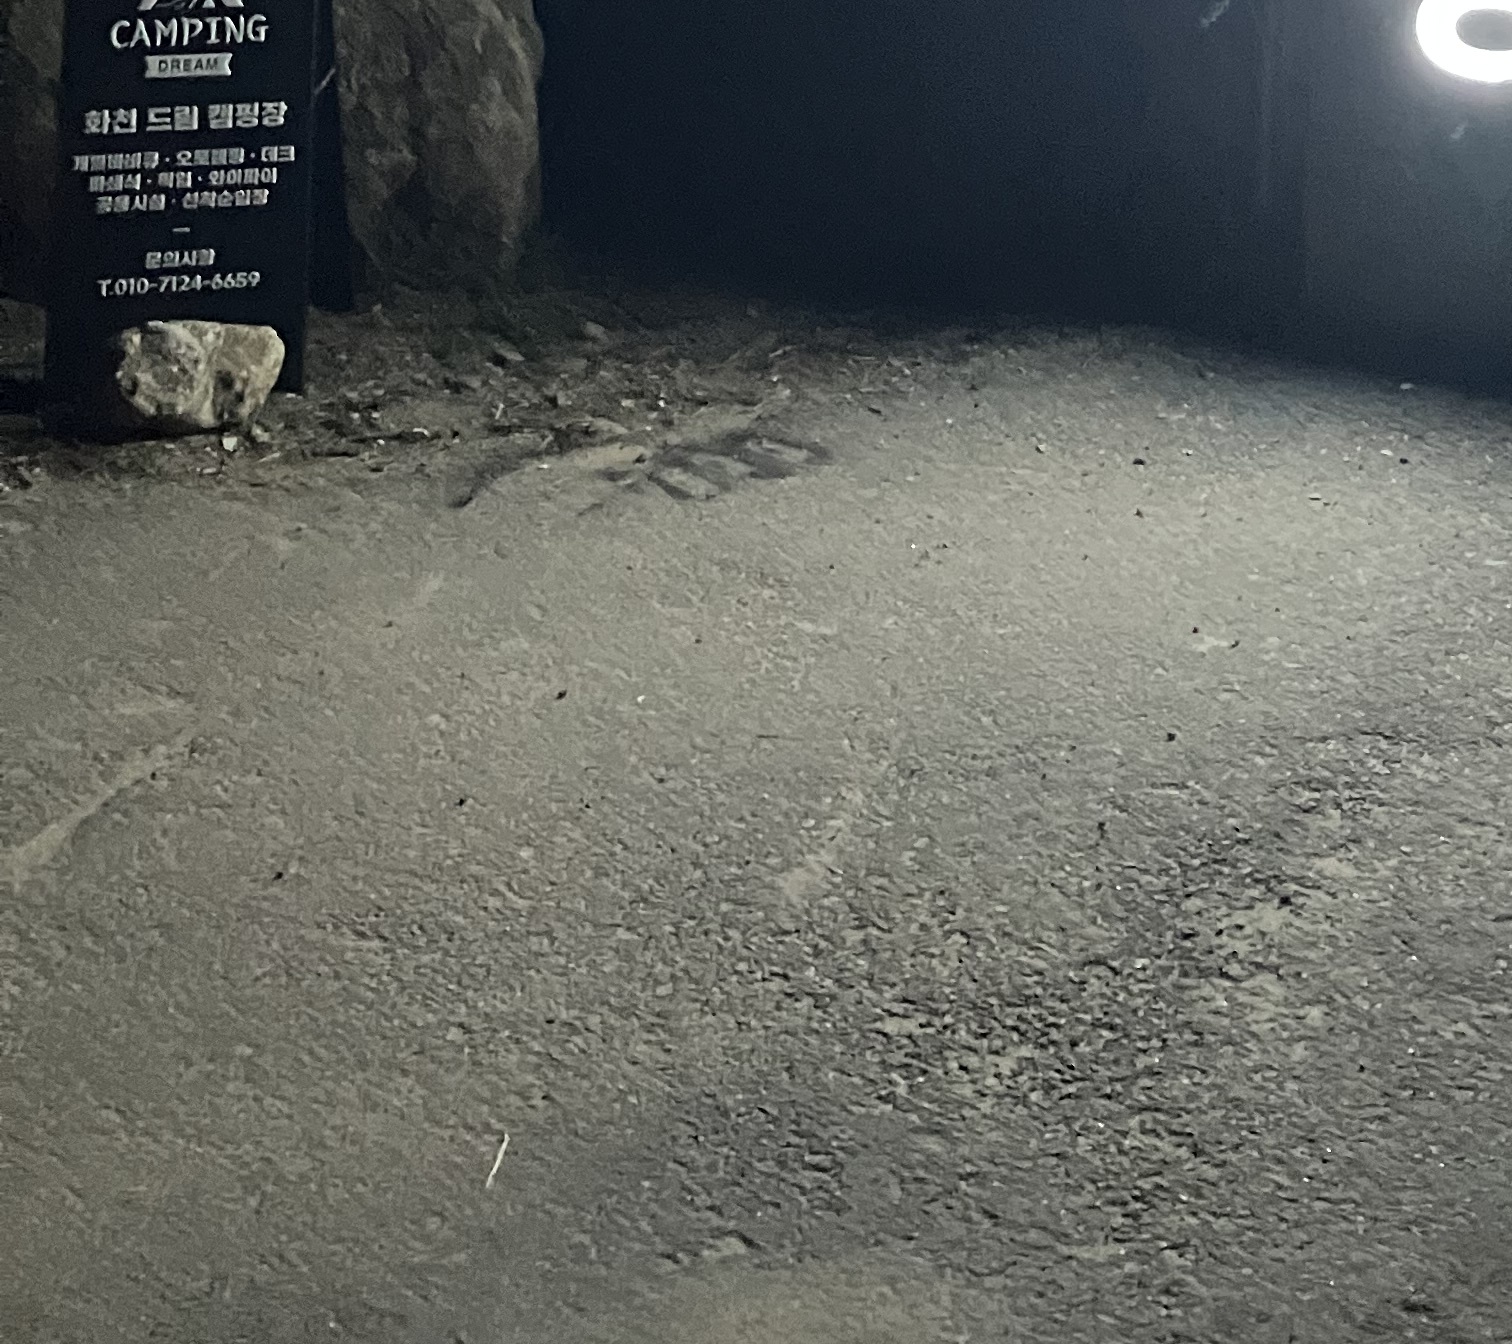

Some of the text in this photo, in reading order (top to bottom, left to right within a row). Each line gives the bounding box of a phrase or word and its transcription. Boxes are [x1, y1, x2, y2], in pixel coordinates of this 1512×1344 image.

[111, 14, 268, 48] CAMPING
[158, 58, 218, 72] DREAM
[85, 101, 287, 134] 화천 드림 캠핑장
[261, 146, 295, 162] 데크
[209, 167, 277, 185] 와이파이
[146, 249, 215, 268] 문의사항
